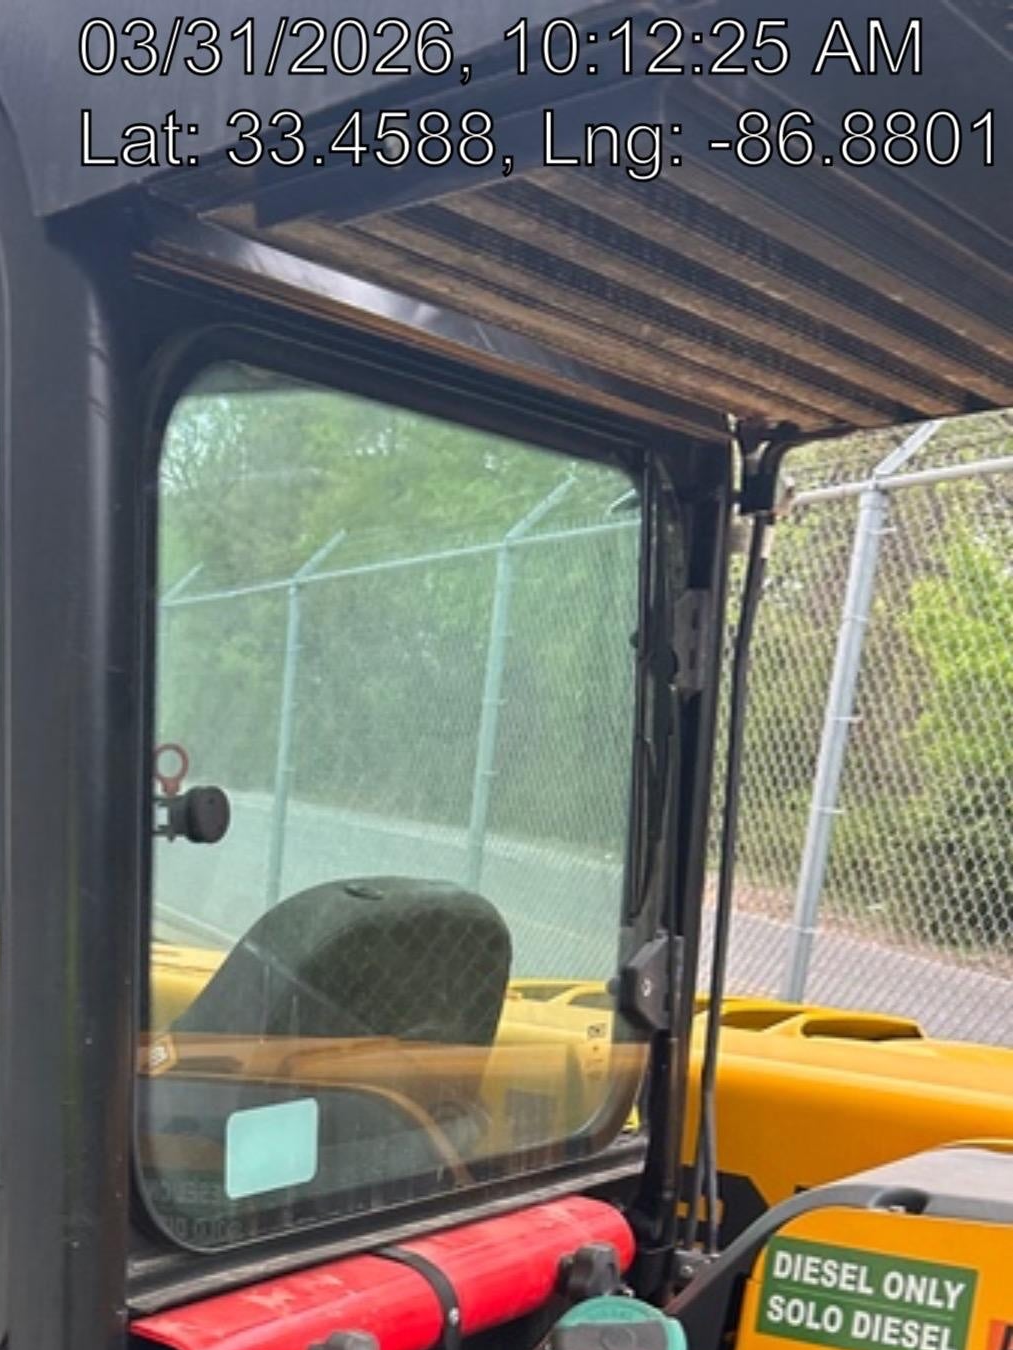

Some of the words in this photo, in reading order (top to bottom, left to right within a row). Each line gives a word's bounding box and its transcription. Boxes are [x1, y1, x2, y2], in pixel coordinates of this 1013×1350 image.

[773, 1251, 874, 1295] DIESEL
[883, 1271, 965, 1310] ONLY
[766, 1295, 843, 1333] SOLO
